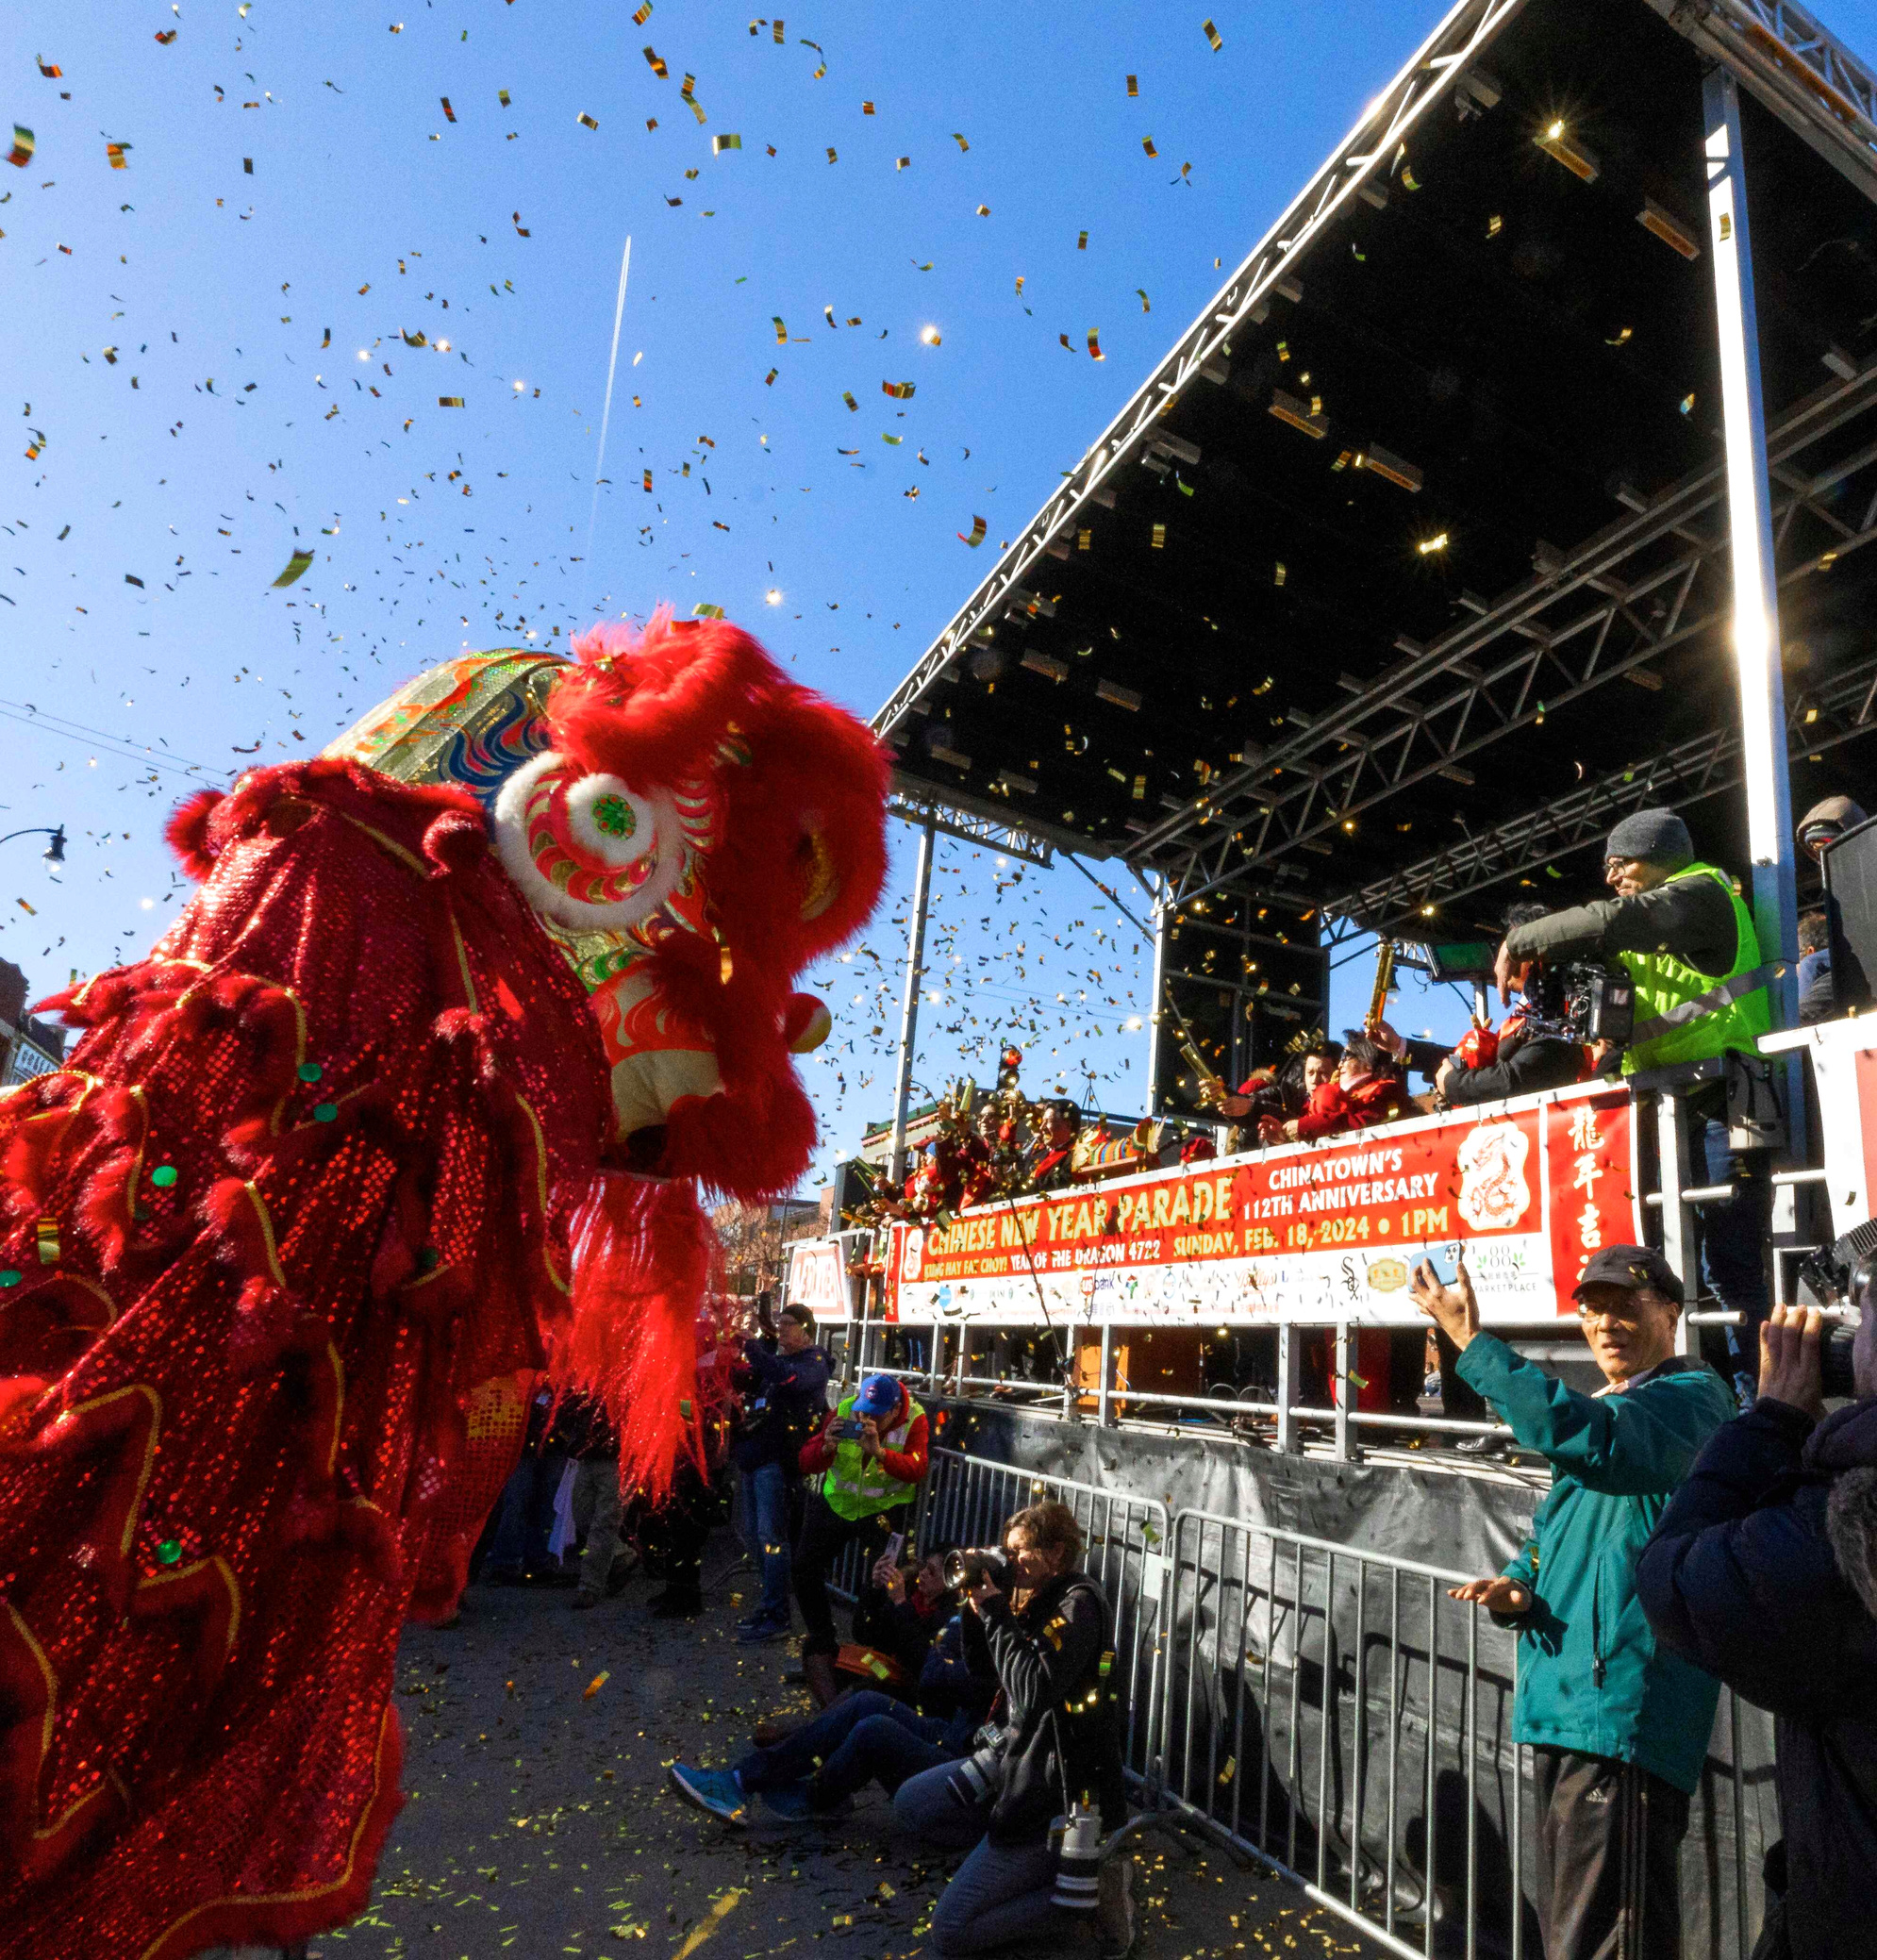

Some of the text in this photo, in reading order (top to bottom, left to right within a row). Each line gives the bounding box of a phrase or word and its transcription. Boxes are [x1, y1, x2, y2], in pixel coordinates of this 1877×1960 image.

[1269, 1148, 1403, 1190] CHINATOWN'S
[927, 1177, 1233, 1256] CHINESE NEW YEAR PARADE
[1243, 1172, 1438, 1221] 112TH ANNIVERSARY
[1173, 1206, 1448, 1257] SUNDAY, FEB. 18, 2024 1PM
[945, 1260, 962, 1276] HAY
[980, 1256, 1008, 1274] CHOY!
[1034, 1252, 1047, 1269] OF
[1052, 1250, 1071, 1268] THE
[1075, 1243, 1125, 1265] DRAGON
[1128, 1240, 1161, 1261] 4722
[1490, 1245, 1511, 1269] 88
